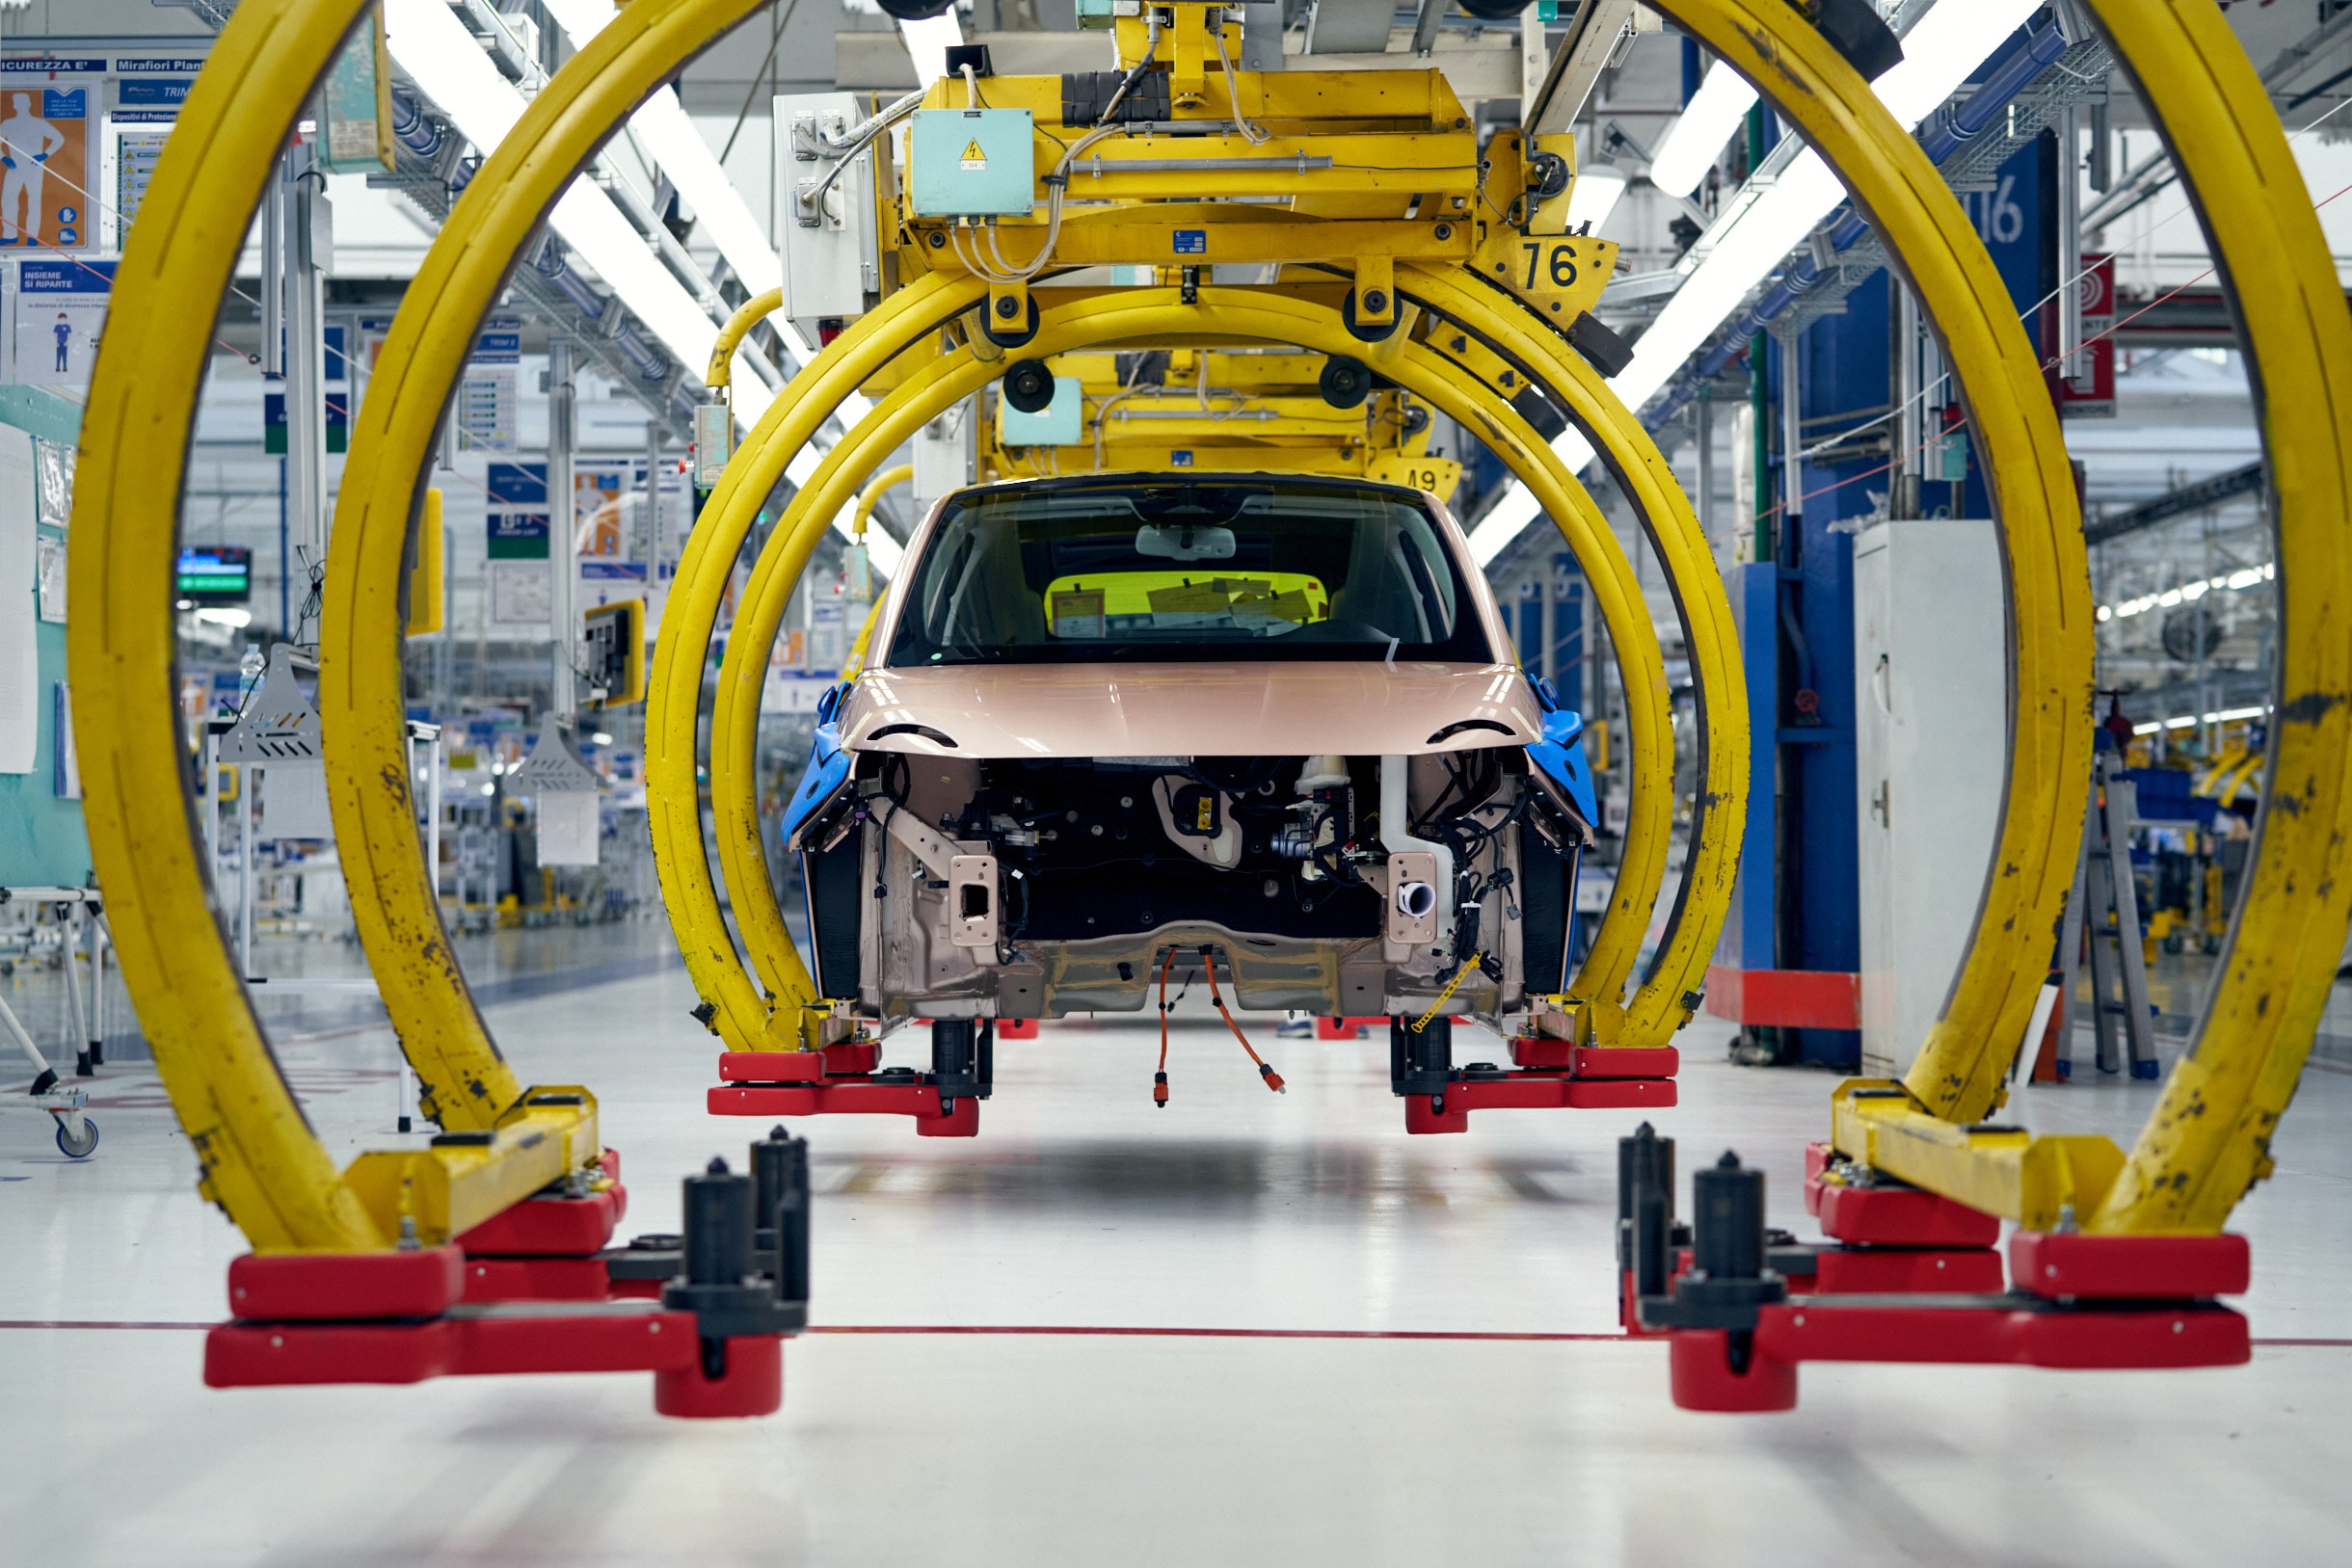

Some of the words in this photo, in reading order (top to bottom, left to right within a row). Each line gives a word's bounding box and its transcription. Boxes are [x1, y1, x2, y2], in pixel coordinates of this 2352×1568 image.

[1, 62, 71, 70] ICUREZZA
[119, 61, 171, 70] Mirafiori
[1964, 176, 2023, 243] 16
[1523, 243, 1577, 289] 76
